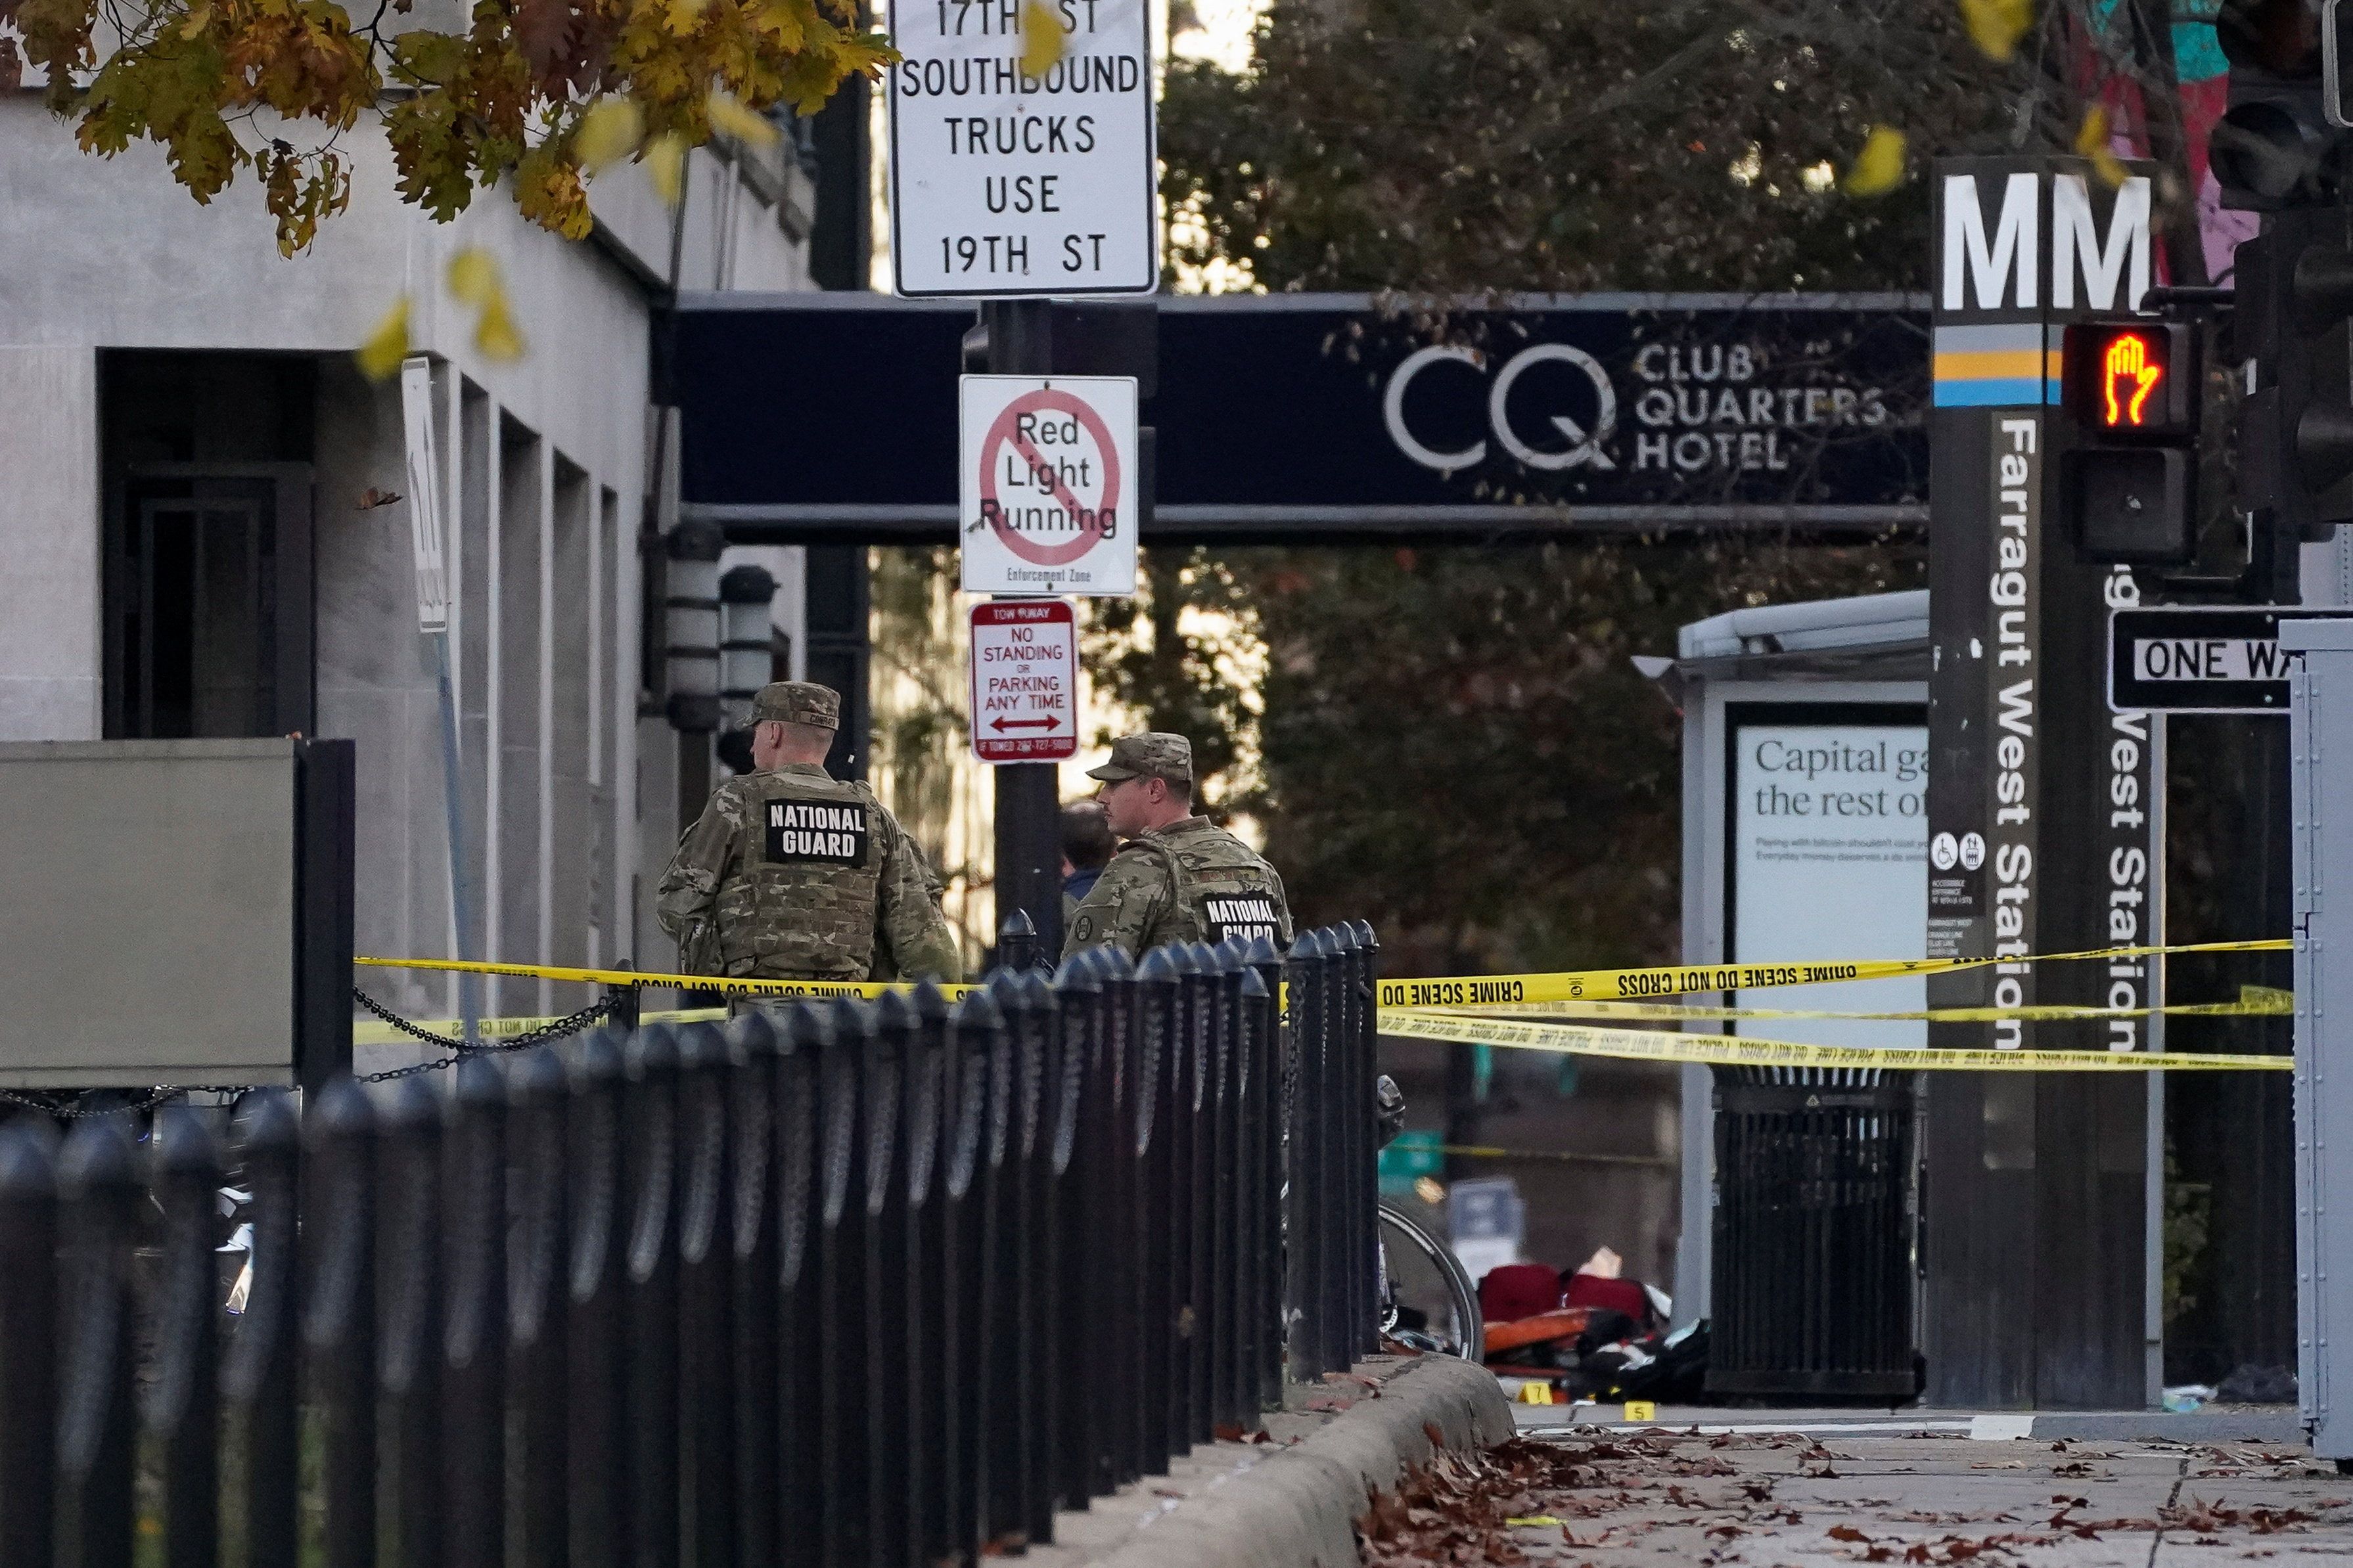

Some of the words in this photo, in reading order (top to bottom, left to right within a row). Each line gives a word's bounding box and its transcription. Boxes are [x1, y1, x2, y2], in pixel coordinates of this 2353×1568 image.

[938, 0, 1018, 35] 17TH
[1059, 0, 1096, 34] ST
[901, 55, 1139, 97] SOUTHBOUND
[944, 116, 1095, 155] TRUCKS
[986, 175, 1060, 213] USE
[942, 235, 1028, 273] 19TH
[1062, 234, 1106, 272] ST
[1943, 172, 2038, 310] M
[2053, 173, 2151, 310] M
[1635, 344, 1754, 382] CLUB
[1383, 342, 1616, 470] CQ
[1635, 387, 1886, 427] QUARTERS
[1016, 411, 1079, 445] Red
[1635, 432, 1789, 470] HOTEL
[1007, 455, 1091, 495] Light
[980, 498, 1116, 540] Running
[1989, 418, 2036, 667] Farragut
[1007, 567, 1065, 582] Enforcement
[1069, 568, 1091, 583] Zone
[1017, 608, 1051, 619] WAY
[1011, 627, 1033, 642] NO
[984, 645, 1062, 662] STANDING
[1017, 664, 1031, 673] OR
[2145, 642, 2227, 679] ONE
[2246, 642, 2291, 678] W
[989, 676, 1059, 692] PARKING
[985, 694, 1020, 711] ANY
[1029, 694, 1065, 709] TIME
[1756, 740, 1886, 780] Capital
[1996, 679, 2034, 826] West
[1756, 784, 1811, 816] the
[1821, 788, 1888, 817] rest
[1898, 790, 1928, 817] o
[771, 804, 865, 832] NATIONAL
[783, 830, 855, 857] GUARD
[1206, 899, 1277, 923] NATIONAL
[1994, 843, 2033, 1050] Station
[2109, 847, 2147, 1052] Station
[1410, 982, 1463, 1005] SCENE
[1469, 980, 1524, 1004] CRIME
[1617, 974, 1673, 997] CROSS
[1678, 972, 1710, 993] NOT
[1716, 970, 1739, 990] DO
[1744, 967, 1797, 988] SCENE
[1382, 985, 1404, 1006] DO
[1534, 1386, 1542, 1404] 7
[1633, 1406, 1645, 1420] 5
